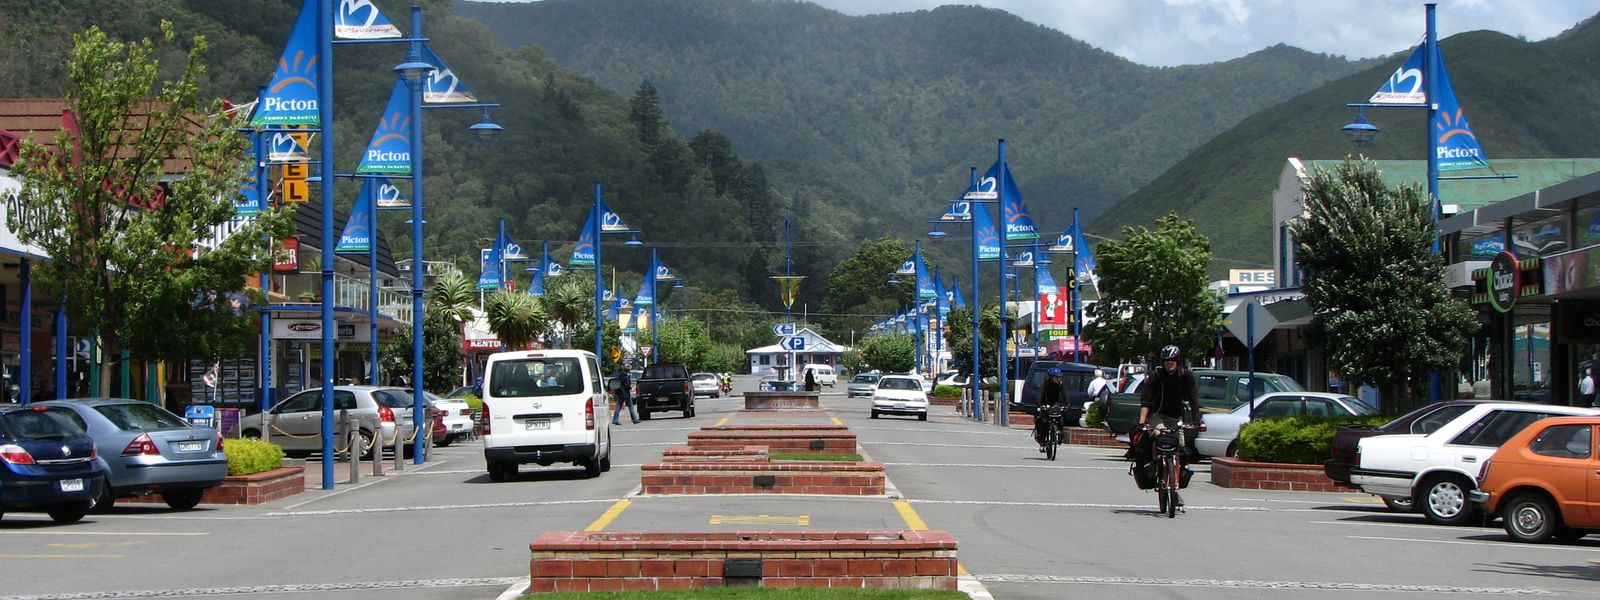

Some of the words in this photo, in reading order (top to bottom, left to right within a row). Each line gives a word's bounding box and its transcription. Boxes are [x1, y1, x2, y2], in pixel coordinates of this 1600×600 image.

[264, 97, 318, 112] Picton
[368, 150, 410, 162] Picton
[1437, 146, 1479, 159] Picton
[1006, 224, 1034, 232] Picton
[342, 235, 369, 244] Picton
[794, 340, 802, 349] P
